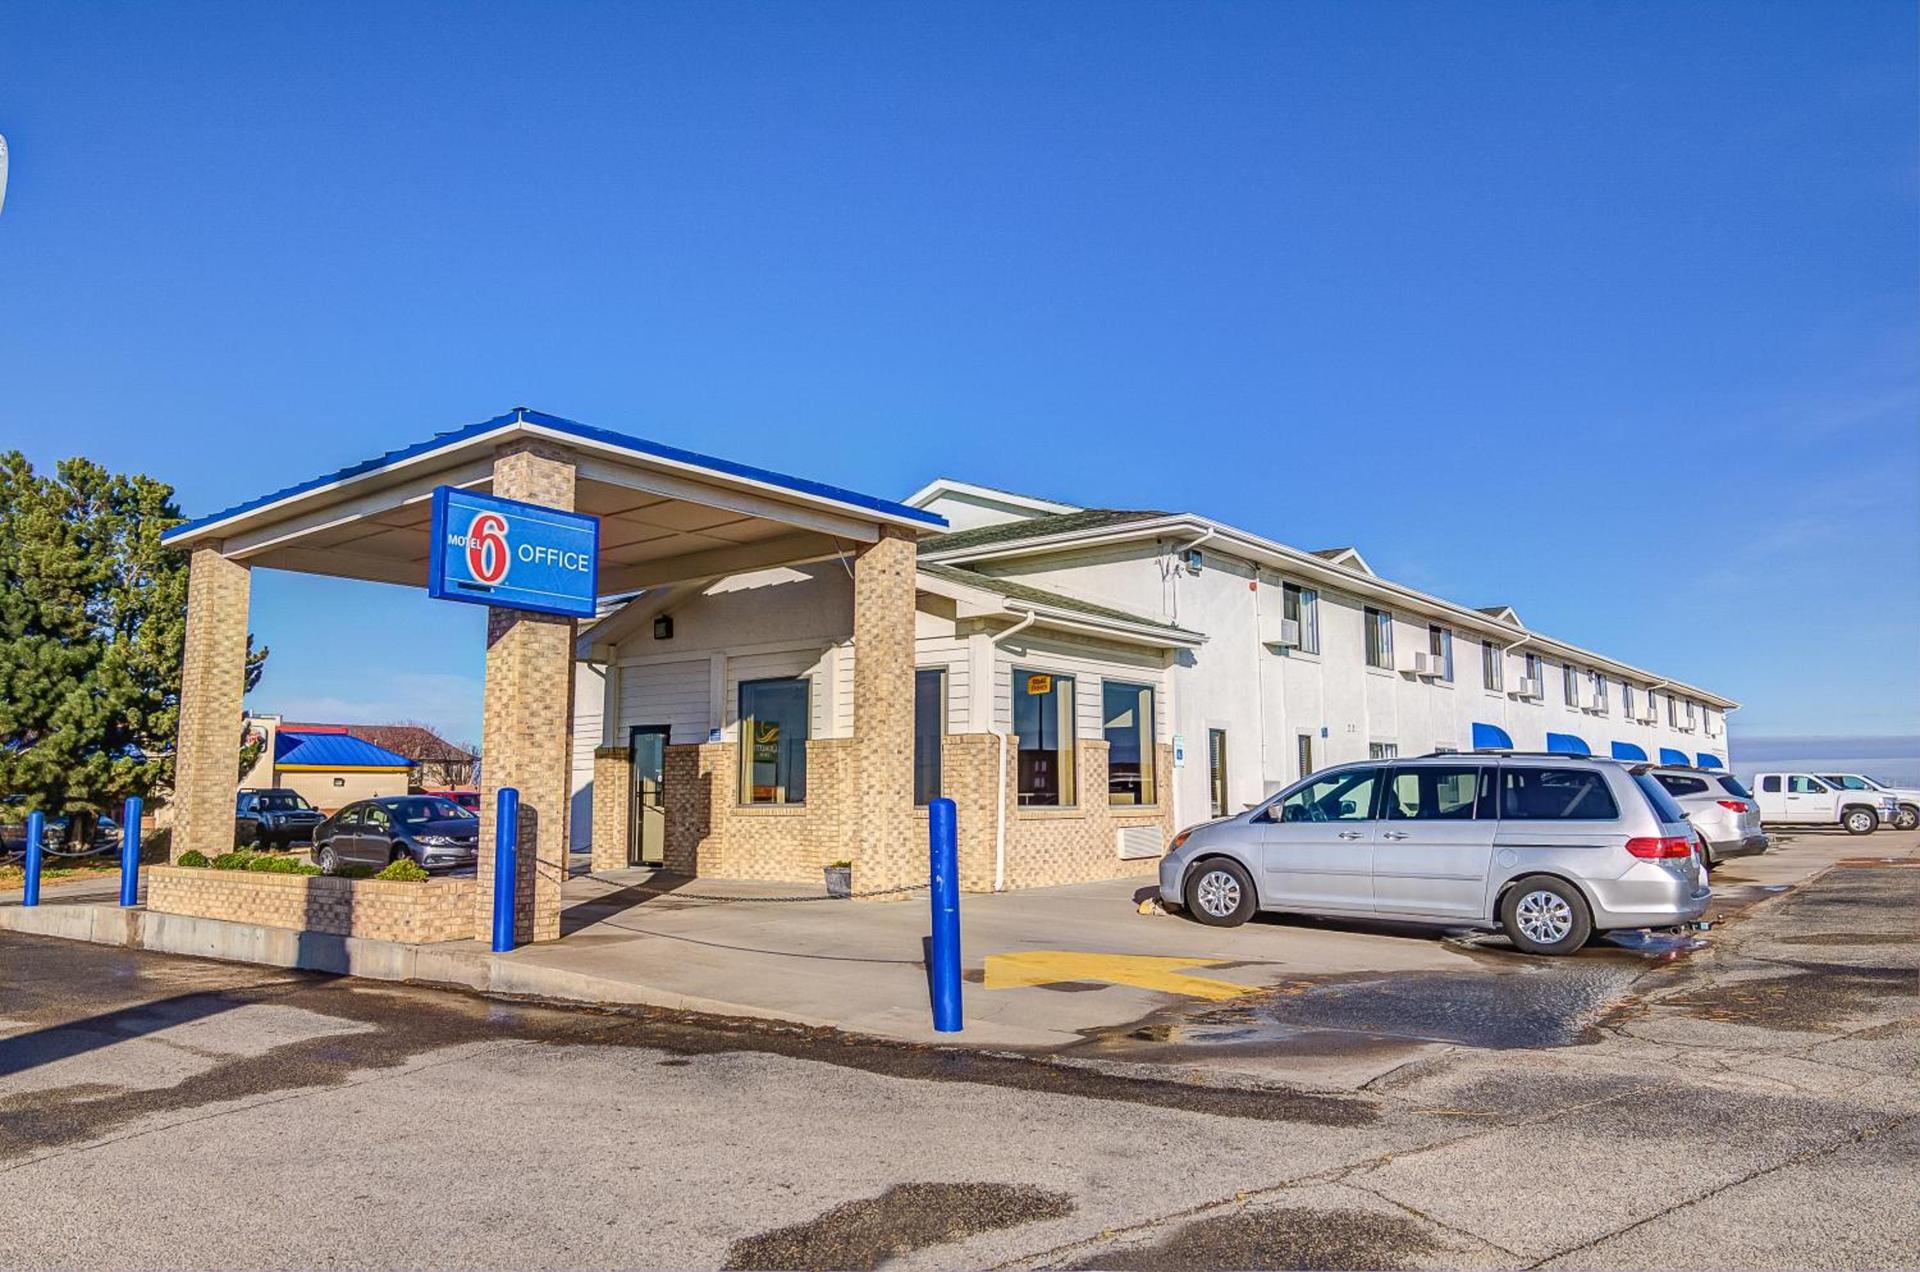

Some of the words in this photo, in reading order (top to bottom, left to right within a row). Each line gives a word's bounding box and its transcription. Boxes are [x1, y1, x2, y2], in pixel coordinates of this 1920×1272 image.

[448, 534, 482, 550] MOTEL
[467, 512, 511, 585] 6
[518, 544, 590, 572] OFFICE
